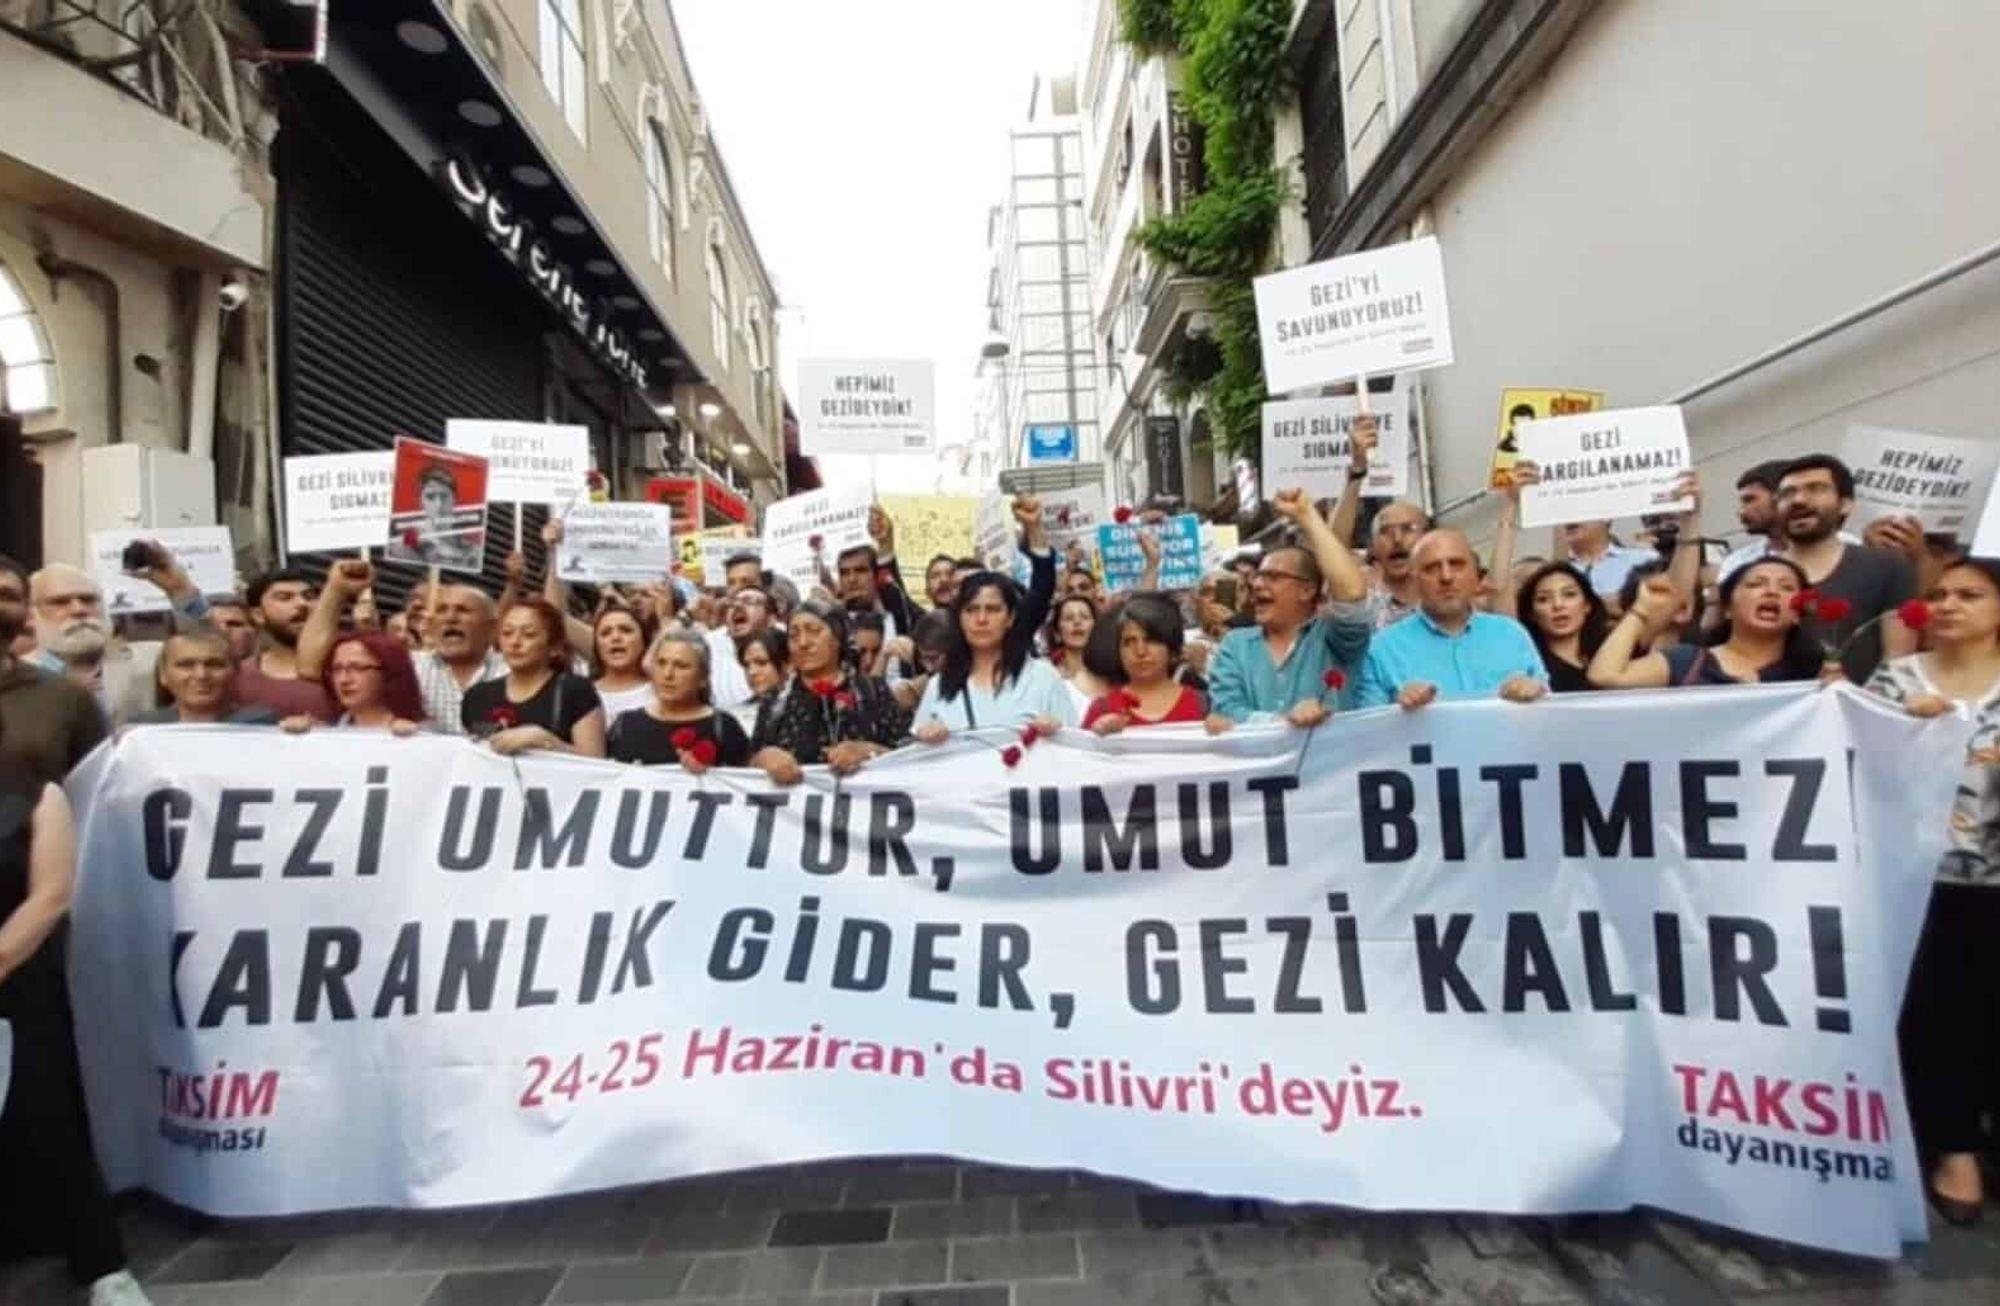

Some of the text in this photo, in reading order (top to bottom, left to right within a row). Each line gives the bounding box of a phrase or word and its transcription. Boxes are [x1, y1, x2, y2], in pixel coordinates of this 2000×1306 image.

[1310, 270, 1379, 307] GEZİ'Yİ
[1276, 291, 1424, 342] SAVUNUYORUZ!
[834, 374, 896, 394] HEPİMİZ
[1273, 416, 1305, 438] GEZİ
[1580, 426, 1621, 453] GEZİ
[1543, 446, 1682, 482] ARGILANAMAZ!
[1880, 449, 1964, 476] HEPİMİZ
[143, 744, 1860, 892] GEZİ UMUTTUR, UMUT BİTMEZ
[706, 895, 1076, 1030] GİDER,
[1125, 892, 1367, 1016] GEZİ
[1413, 905, 1853, 1034] KALIR!
[519, 1023, 1423, 1134] 24-25 Haziran'da Silivri'deyiz.
